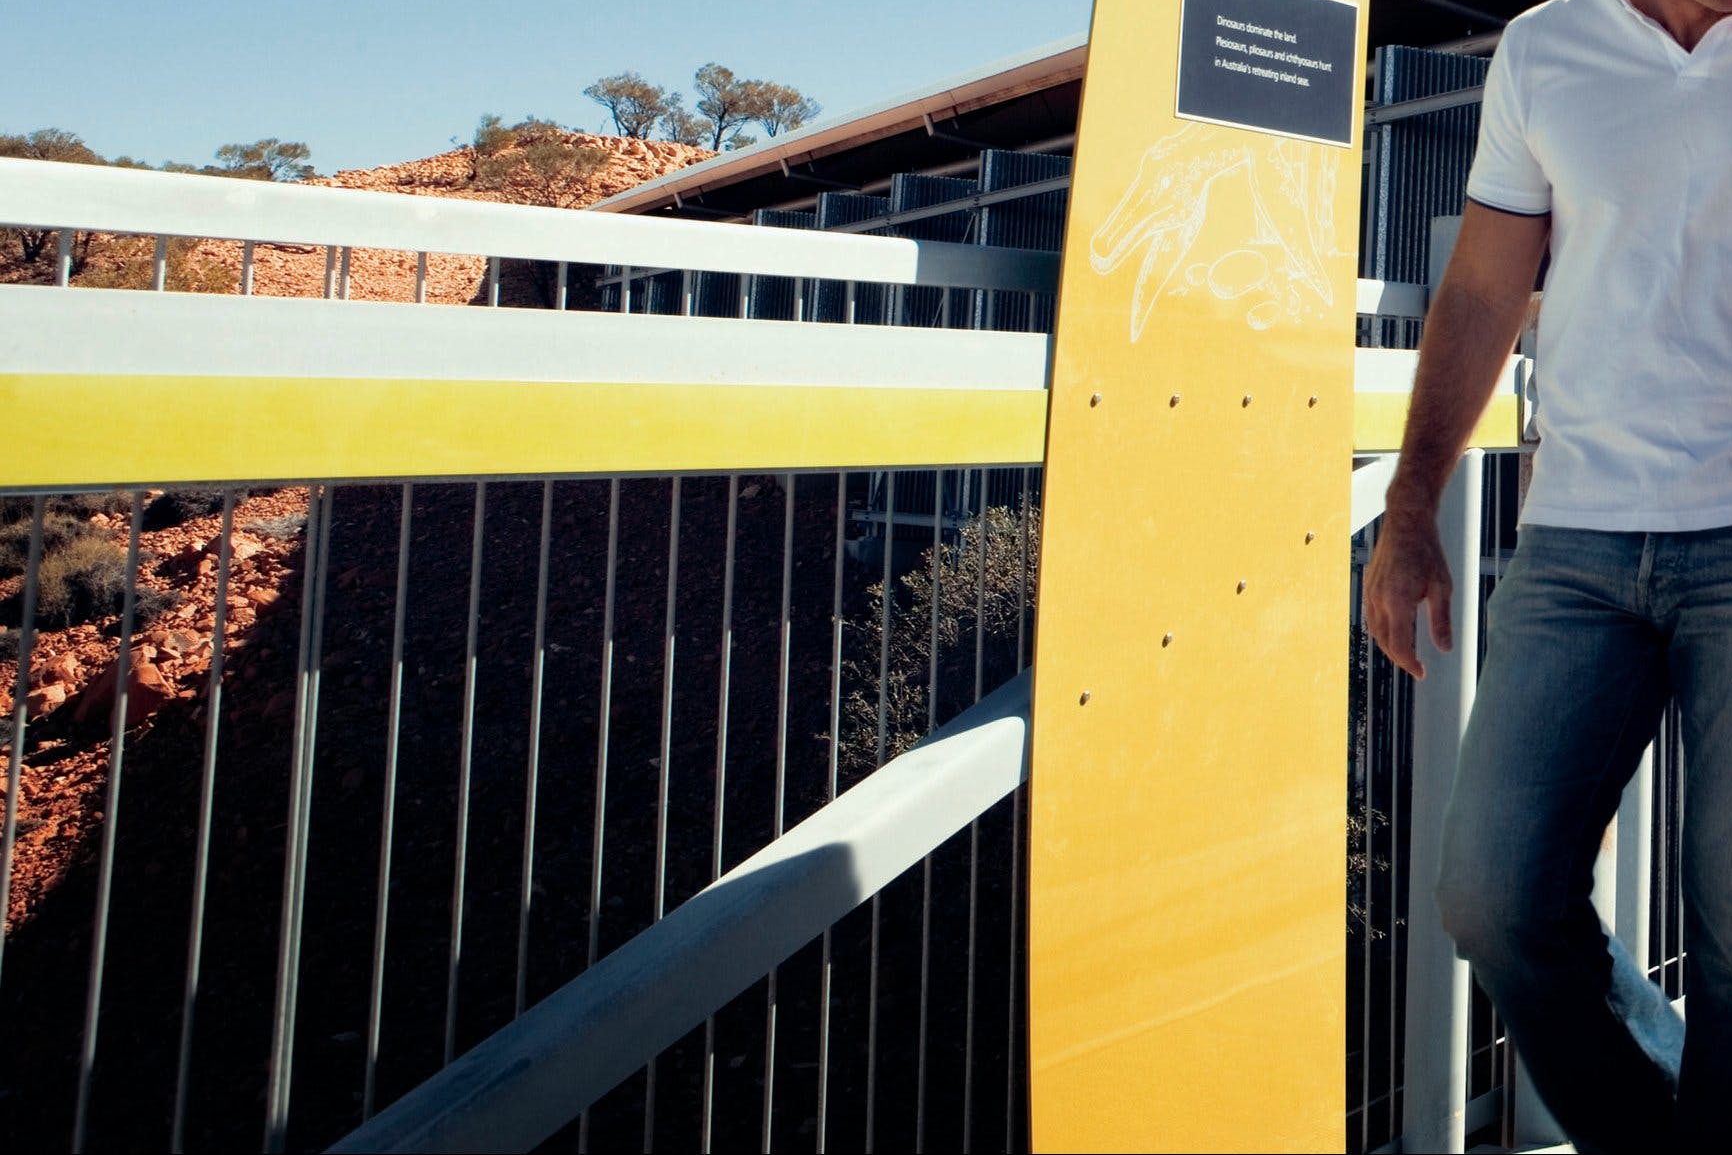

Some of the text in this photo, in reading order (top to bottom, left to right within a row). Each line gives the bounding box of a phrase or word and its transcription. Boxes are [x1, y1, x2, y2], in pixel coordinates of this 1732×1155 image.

[1217, 15, 1245, 31] Dinosaurs
[1246, 23, 1273, 38] dominate
[1274, 29, 1283, 41] the
[1215, 56, 1221, 67] in
[1222, 59, 1251, 74] Australia's
[1252, 67, 1279, 82] retreating
[1280, 71, 1296, 84] inland
[1249, 44, 1273, 59] pliosaurs
[1274, 51, 1285, 62] and
[1319, 60, 1332, 72] hunt
